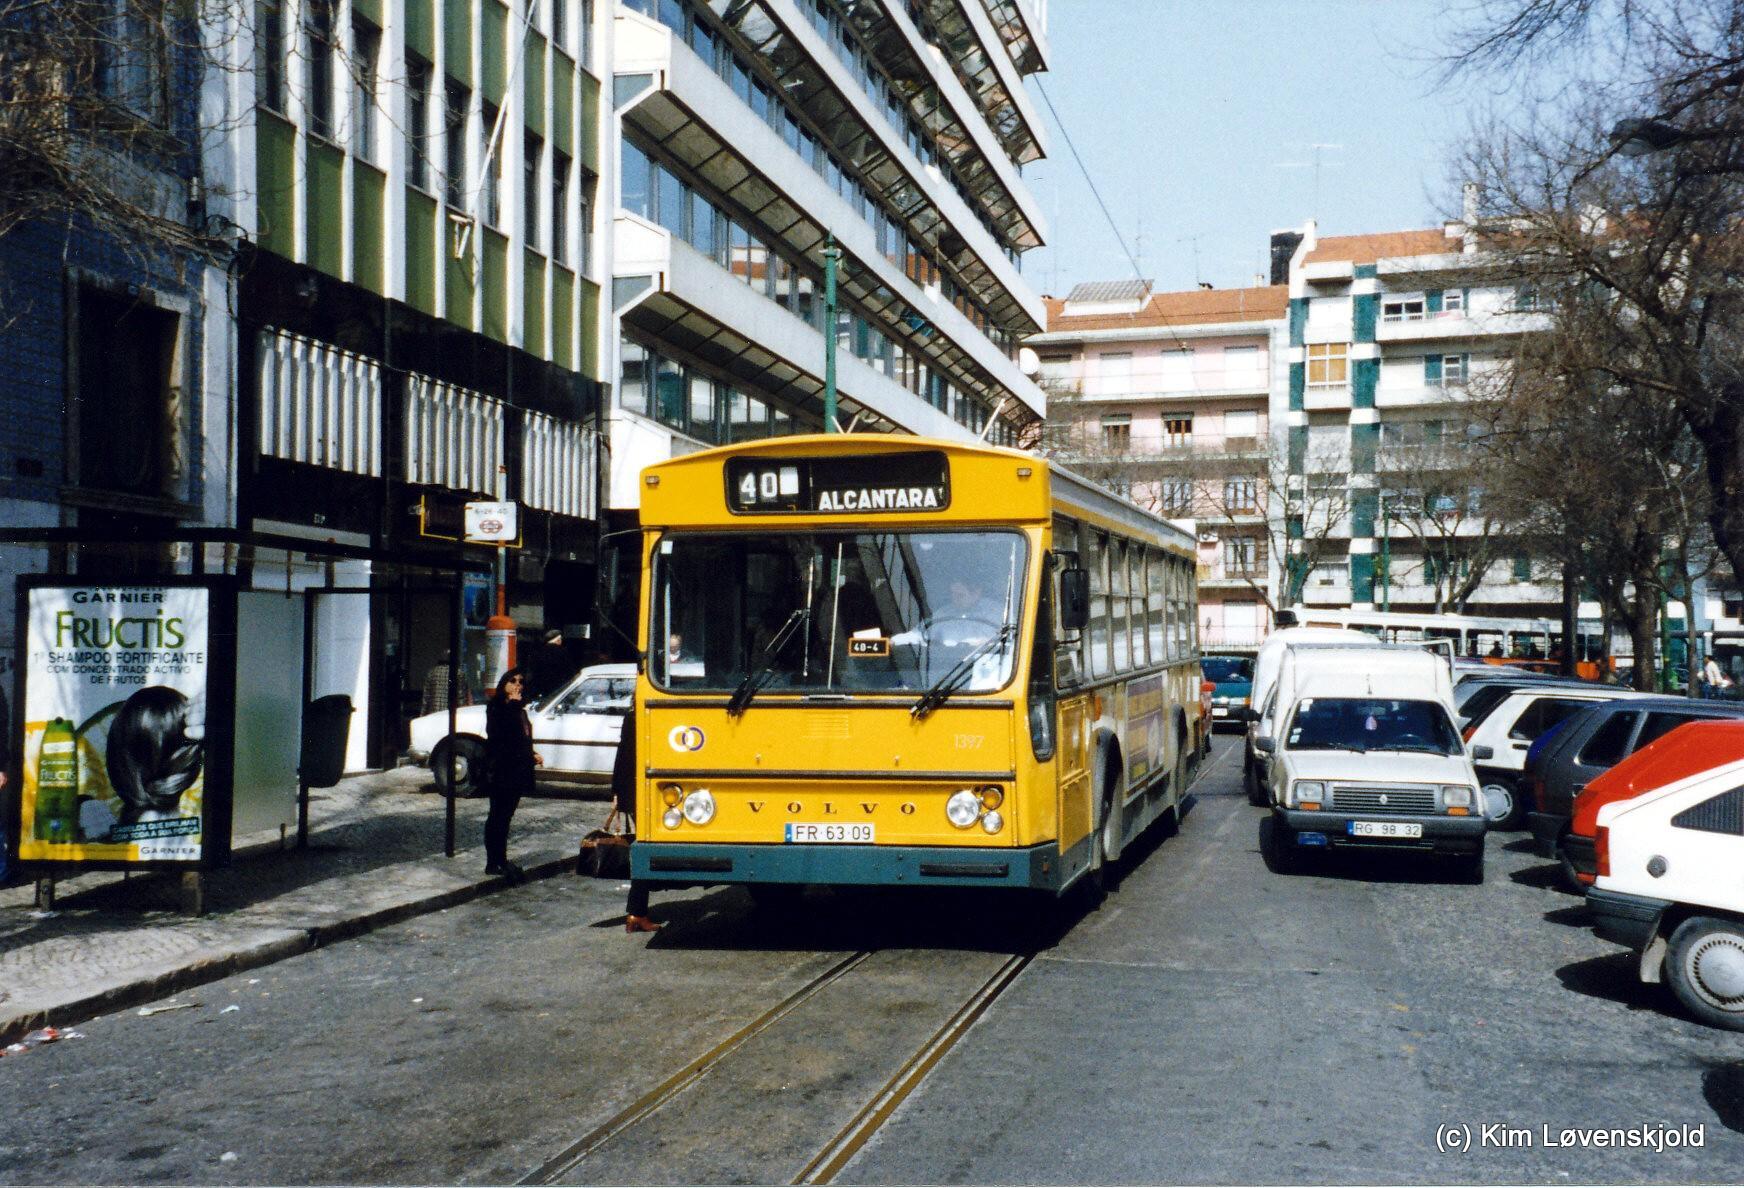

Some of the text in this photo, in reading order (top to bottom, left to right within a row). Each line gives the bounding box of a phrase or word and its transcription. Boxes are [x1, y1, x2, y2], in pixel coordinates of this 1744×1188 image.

[741, 472, 778, 498] 40
[818, 488, 938, 511] ALCANTARA
[73, 591, 164, 604] GARNIER
[49, 652, 112, 664] SHAMPOO
[116, 652, 204, 664] FORTIFICANTE
[73, 665, 150, 674] CONCENTRADO
[90, 675, 147, 685] DE FRUTOS
[953, 734, 985, 750] 1397
[747, 801, 915, 815] VOLVO
[796, 825, 871, 840] FR 63 09
[1355, 823, 1420, 836] RG 98 32
[141, 846, 196, 854] GARNIER
